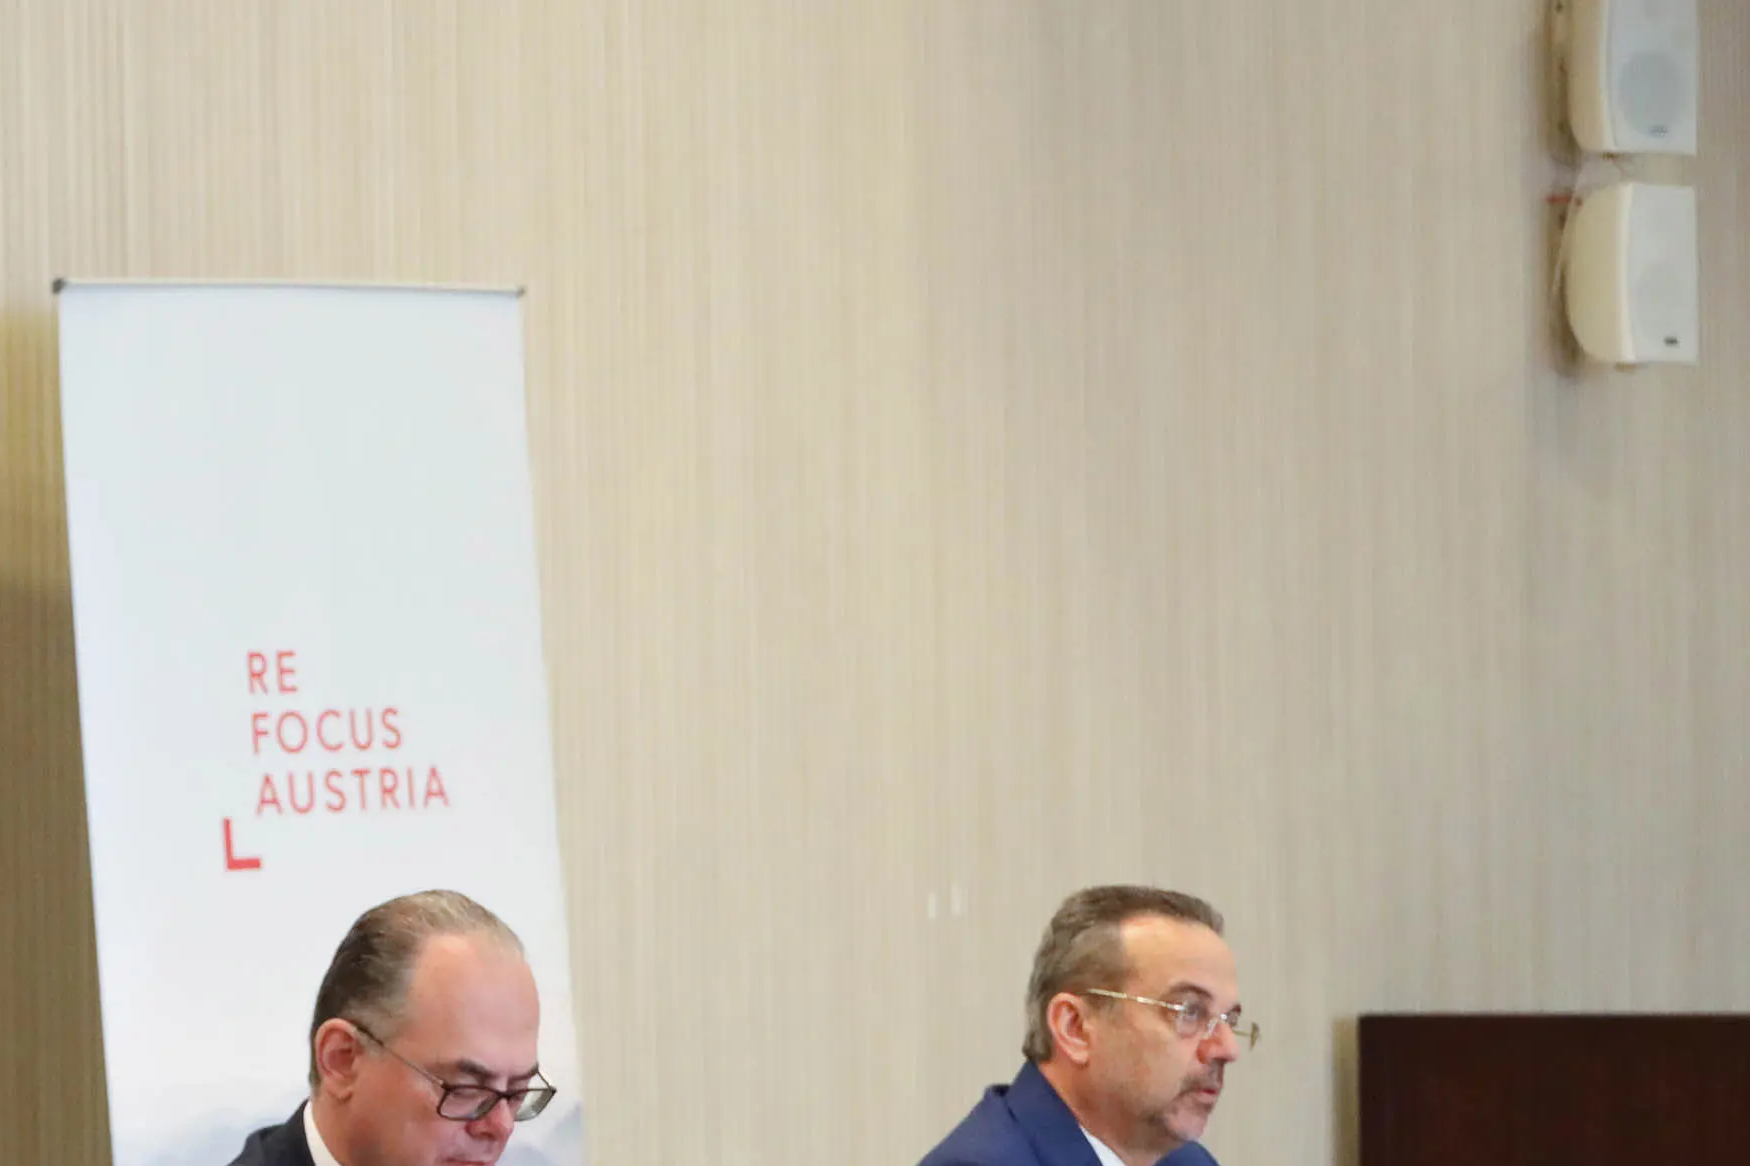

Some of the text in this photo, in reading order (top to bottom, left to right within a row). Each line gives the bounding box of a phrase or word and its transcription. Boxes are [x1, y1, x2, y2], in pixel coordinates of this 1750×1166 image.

[247, 651, 298, 694] RE
[251, 706, 403, 755] FOCUS
[256, 765, 451, 816] AUSTRIA
